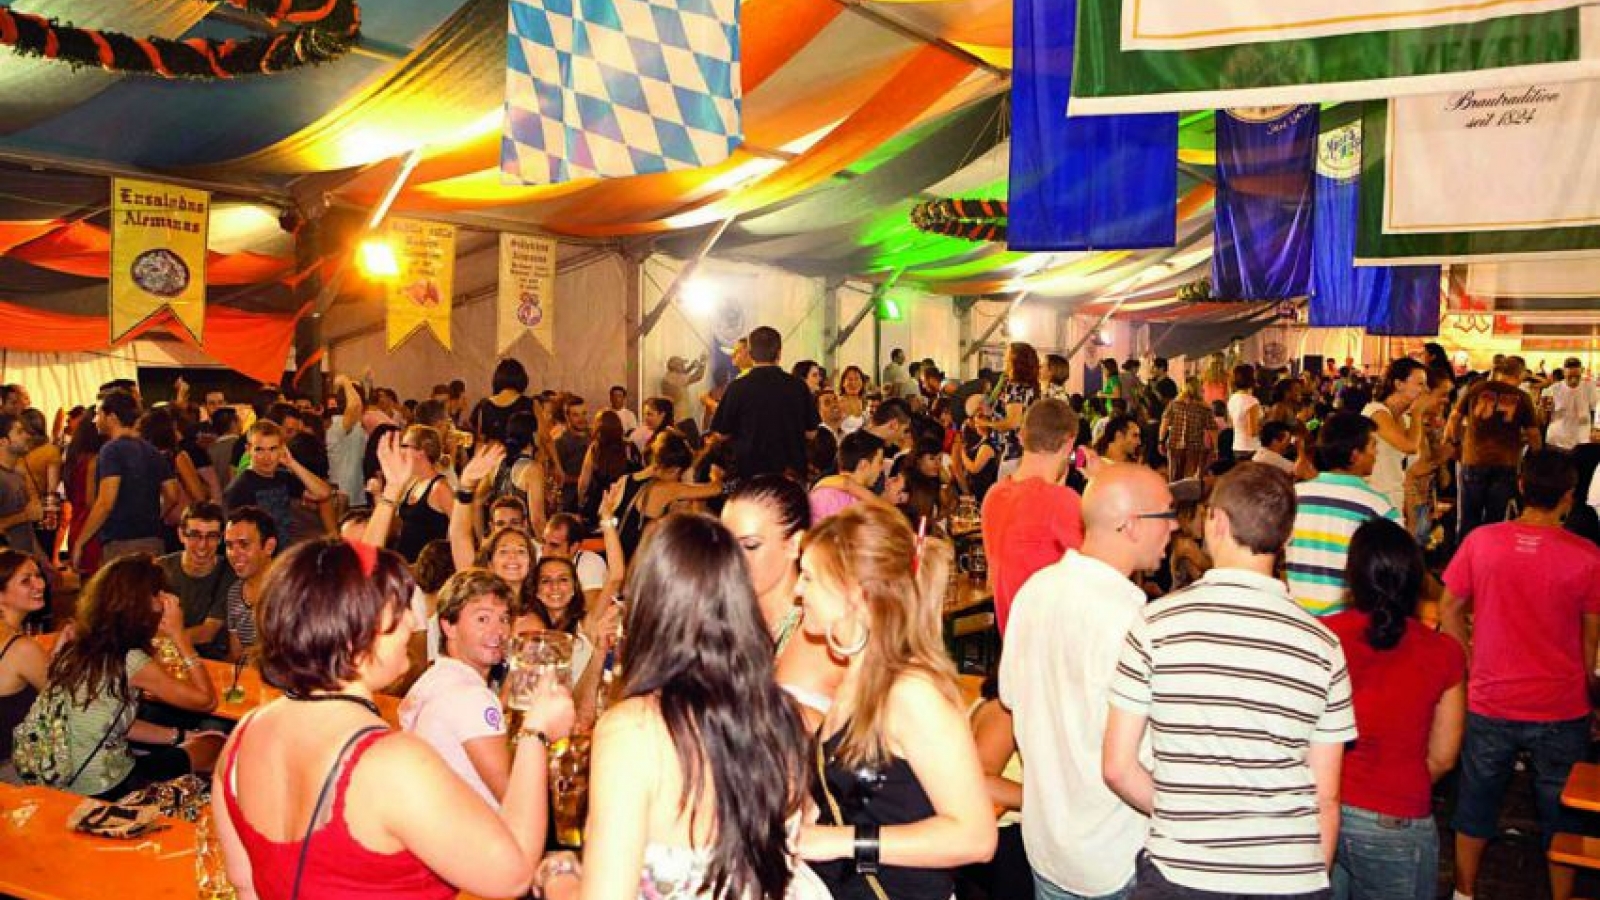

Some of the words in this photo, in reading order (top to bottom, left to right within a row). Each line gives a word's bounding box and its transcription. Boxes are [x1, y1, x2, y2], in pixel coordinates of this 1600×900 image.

[1465, 112, 1495, 128] seit
[1497, 108, 1536, 125] 1824
[123, 210, 200, 233] Alemanas
